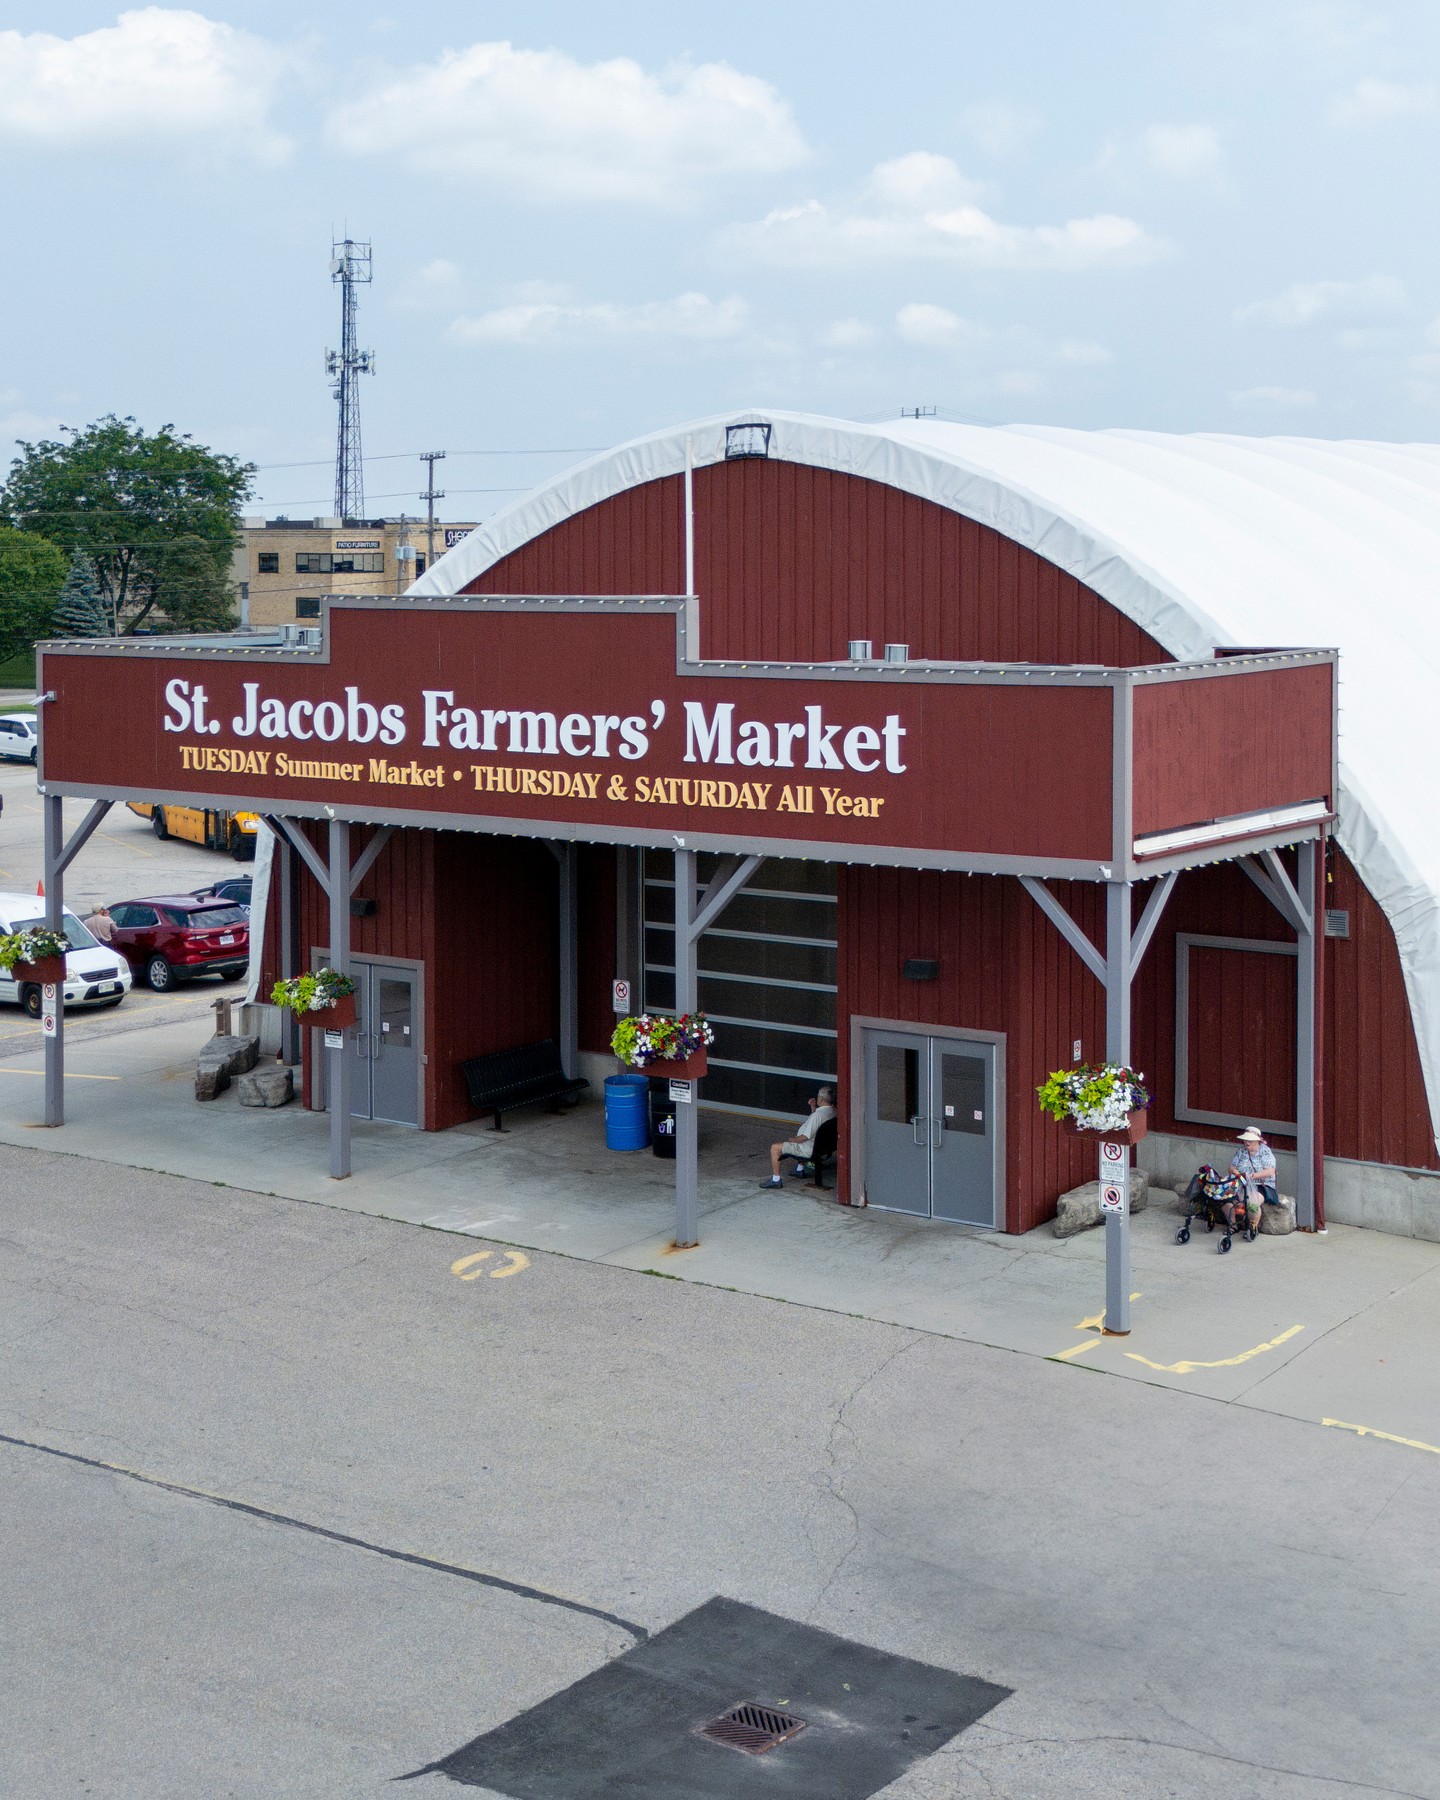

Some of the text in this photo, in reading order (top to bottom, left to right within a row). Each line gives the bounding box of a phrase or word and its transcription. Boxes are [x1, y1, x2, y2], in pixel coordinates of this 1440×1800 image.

[164, 679, 221, 735] St.
[232, 683, 407, 745] Jacobs
[683, 701, 908, 774] Market
[179, 745, 885, 818] TUESDAY Summer Market THURSDAY & SATURDAY All Year
